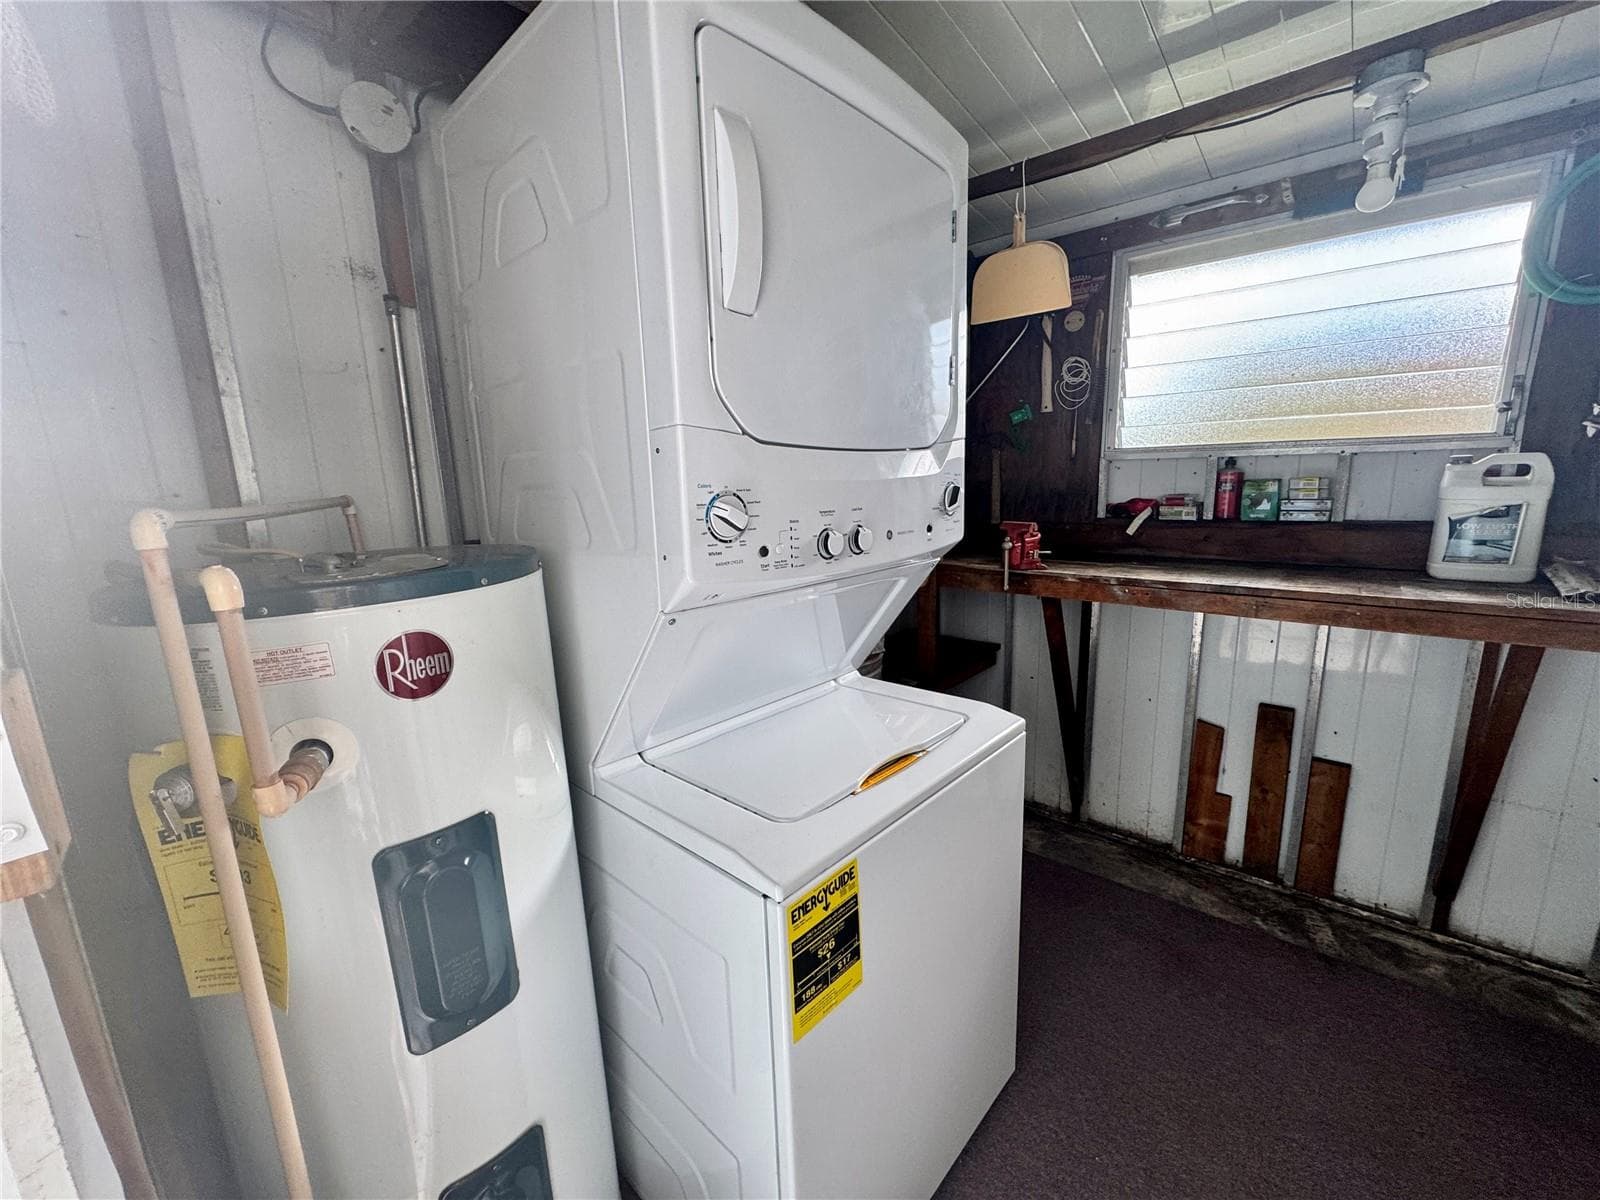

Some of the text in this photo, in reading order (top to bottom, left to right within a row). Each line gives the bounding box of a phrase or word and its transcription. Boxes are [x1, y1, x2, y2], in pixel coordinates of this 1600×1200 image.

[382, 633, 451, 693] Rheem
[791, 865, 856, 925] ENERGYGUIDE
[817, 937, 836, 958] $26
[837, 953, 852, 970] $17
